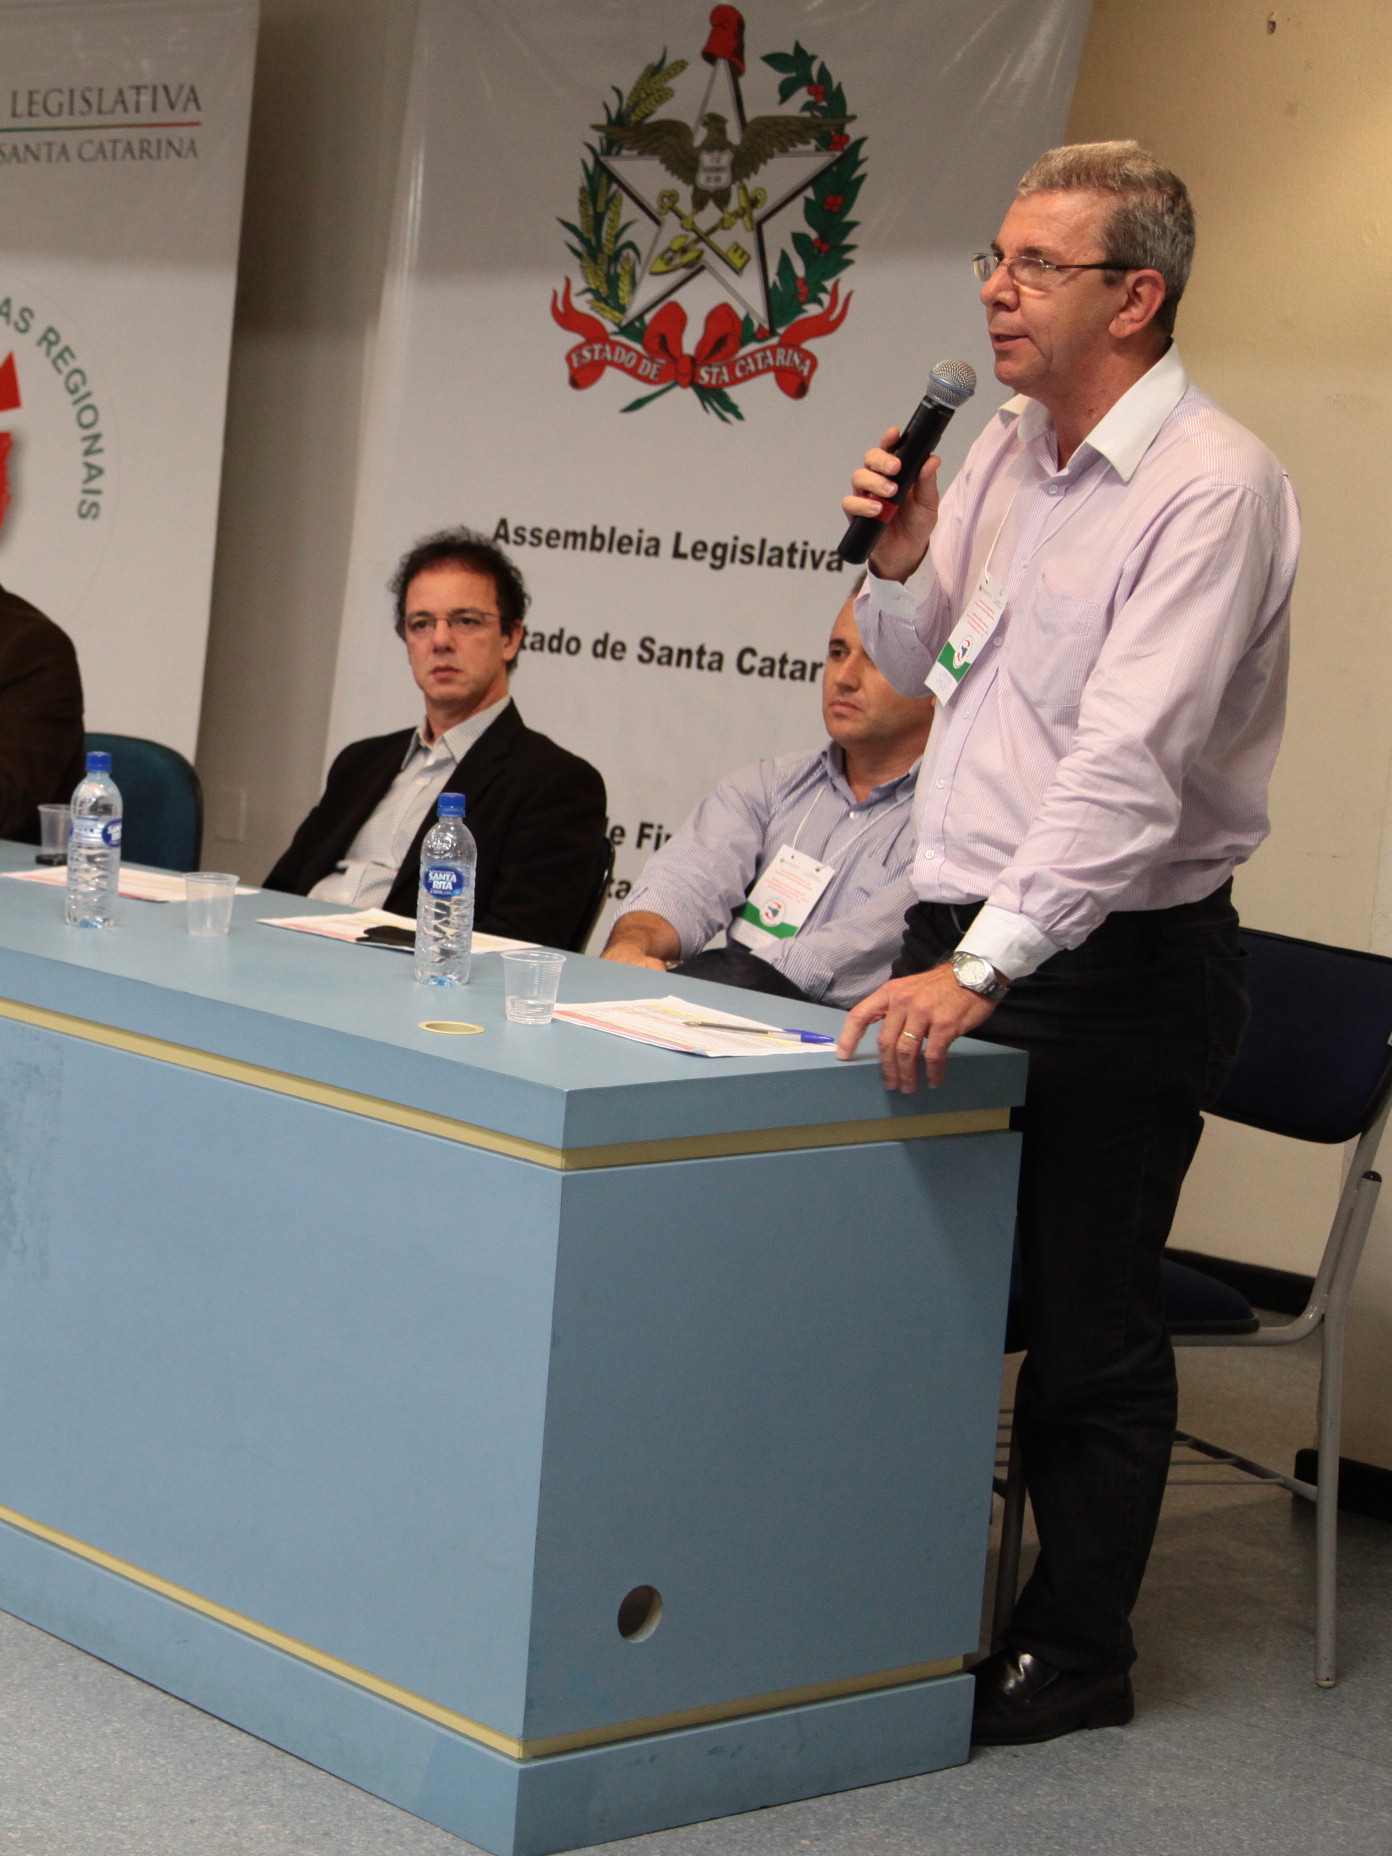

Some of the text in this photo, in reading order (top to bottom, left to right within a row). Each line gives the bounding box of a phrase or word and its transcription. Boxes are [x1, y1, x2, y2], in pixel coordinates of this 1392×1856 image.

[10, 83, 203, 120] LEGISLATIVA
[77, 137, 199, 162] CATARINA
[570, 343, 638, 369] ESTADO
[637, 357, 664, 382] DE
[734, 346, 812, 378] CATARINA
[36, 325, 106, 521] REGIONAIS
[492, 517, 845, 573] Assembleia Legislativa
[519, 624, 825, 684] tado de Santa Catar
[428, 870, 457, 883] SANTA
[432, 880, 454, 891] RITA
